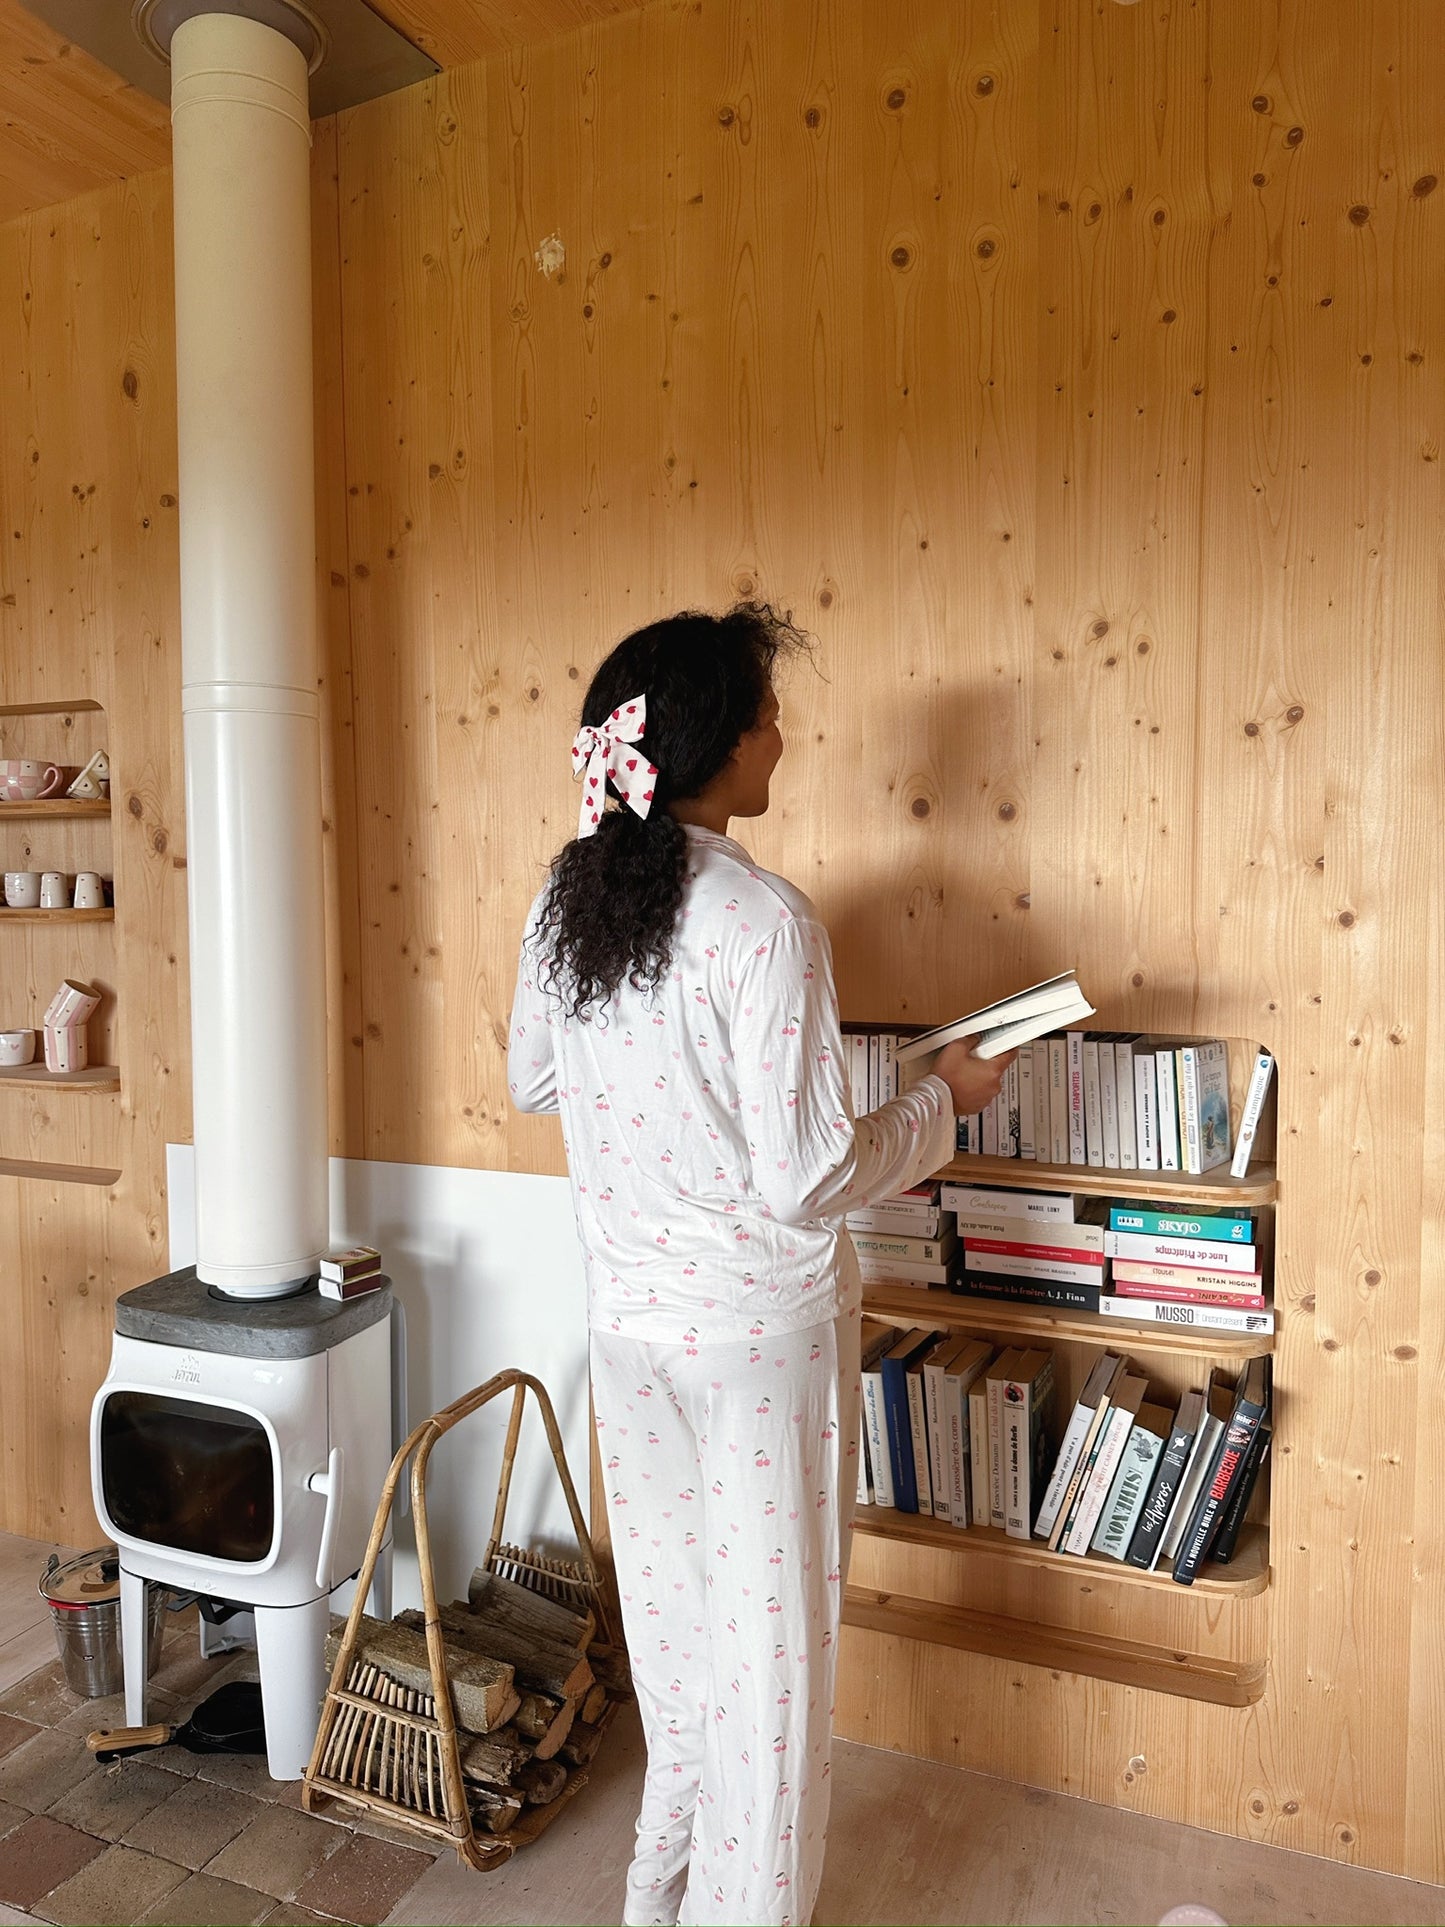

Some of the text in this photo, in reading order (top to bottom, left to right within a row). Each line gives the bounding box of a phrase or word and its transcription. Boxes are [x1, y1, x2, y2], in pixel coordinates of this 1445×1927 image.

[1072, 1071, 1080, 1111] M'EMPORTES
[1245, 1076, 1264, 1127] La campagne
[1188, 1112, 1194, 1122] Le
[1028, 1204, 1044, 1212] MARIE
[1158, 1219, 1201, 1235] SKYJO
[1155, 1245, 1228, 1263] Lune de Printemps
[978, 1282, 1003, 1292] femme
[1019, 1286, 1046, 1297] fenêtre
[1197, 1276, 1257, 1288] KRISTAN HIGGINS
[1047, 1290, 1085, 1302] A. J. Finn
[1155, 1304, 1194, 1324] MUSSO
[866, 1380, 875, 1399] Dieu
[990, 1385, 998, 1404] dodo
[869, 1399, 876, 1408] de
[990, 1406, 998, 1415] du
[870, 1408, 880, 1432] plaisir
[1235, 1413, 1252, 1425] weber
[991, 1428, 998, 1438] Le
[1010, 1425, 1018, 1442] Berlin
[950, 1415, 963, 1502] La poussière des corons
[992, 1476, 1000, 1509] Geneviève
[1105, 1470, 1142, 1541] SIMENON
[1142, 1481, 1173, 1533] les Apéros
[1185, 1448, 1240, 1568] LA NOUVELLE BIBLE DU BARBECUE
